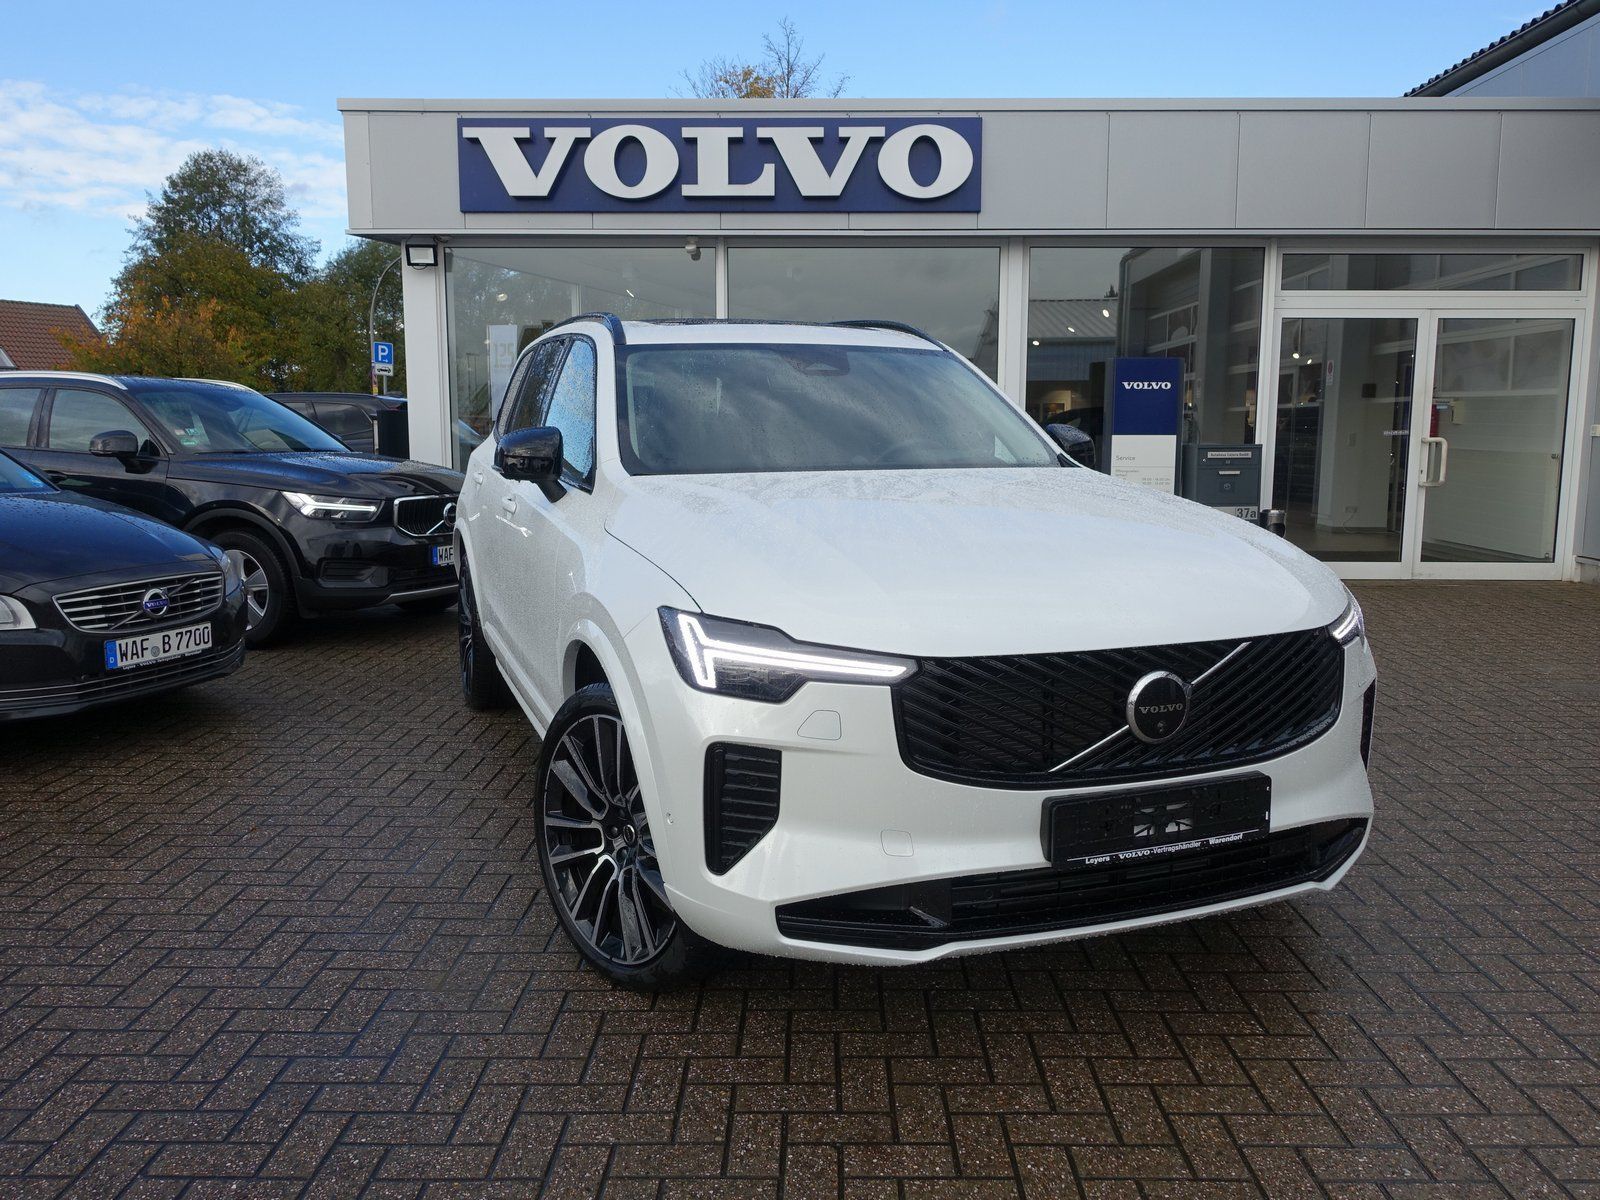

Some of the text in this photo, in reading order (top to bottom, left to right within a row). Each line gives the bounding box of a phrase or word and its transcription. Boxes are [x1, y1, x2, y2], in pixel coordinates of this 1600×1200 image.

[462, 124, 973, 199] VOLVO
[378, 345, 389, 361] P
[1122, 381, 1171, 390] VOLVO
[1236, 507, 1257, 519] 37a
[146, 599, 168, 608] VOLVO
[118, 637, 150, 663] WAF
[162, 634, 172, 654] B
[175, 626, 210, 651] 7700
[1138, 702, 1184, 715] VOLVO
[1085, 856, 1110, 865] Leyers
[1208, 832, 1243, 845] Warendorf
